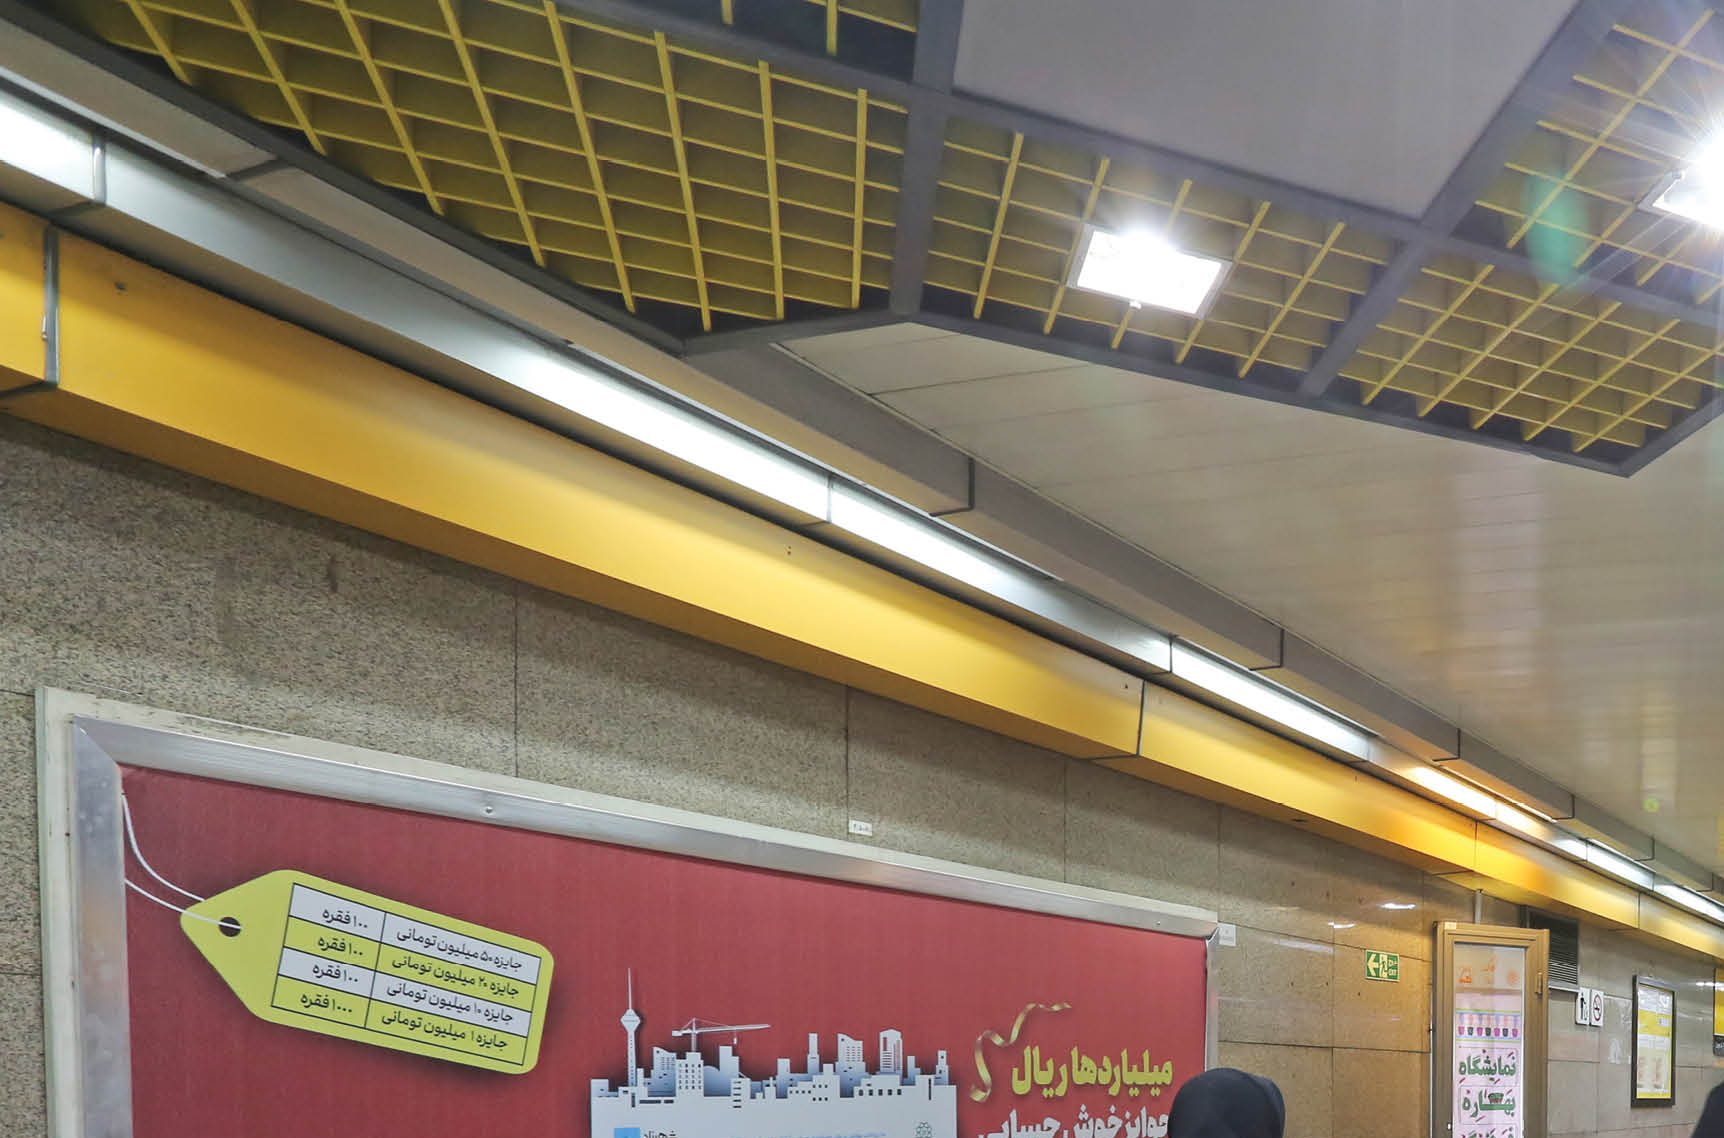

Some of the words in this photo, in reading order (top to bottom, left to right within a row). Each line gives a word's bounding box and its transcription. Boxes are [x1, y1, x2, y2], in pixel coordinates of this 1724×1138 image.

[322, 909, 351, 924] فقره
[353, 915, 368, 928] ۱۰۰
[318, 937, 346, 952] فقره
[396, 929, 437, 948] تومانی
[349, 943, 363, 955] ۱۰۰
[437, 941, 479, 959] میلیون
[312, 964, 341, 979] فقره
[392, 955, 432, 975] تومانی
[494, 955, 523, 972] جایزه
[344, 969, 358, 982] ۱۰۰
[433, 967, 476, 985] میلیون
[386, 983, 428, 1003] تومانی
[489, 983, 519, 999] جایزه
[300, 993, 329, 1009] فقره
[332, 998, 352, 1013] ۱۰۰۰
[428, 993, 471, 1012] میلیون
[381, 1011, 423, 1031] تومانی
[483, 1007, 513, 1025] جایزه
[423, 1021, 466, 1040] میلیون
[476, 1031, 508, 1051] جایزه
[1011, 1044, 1069, 1098] ریال
[1070, 1045, 1173, 1097] میلیاردها
